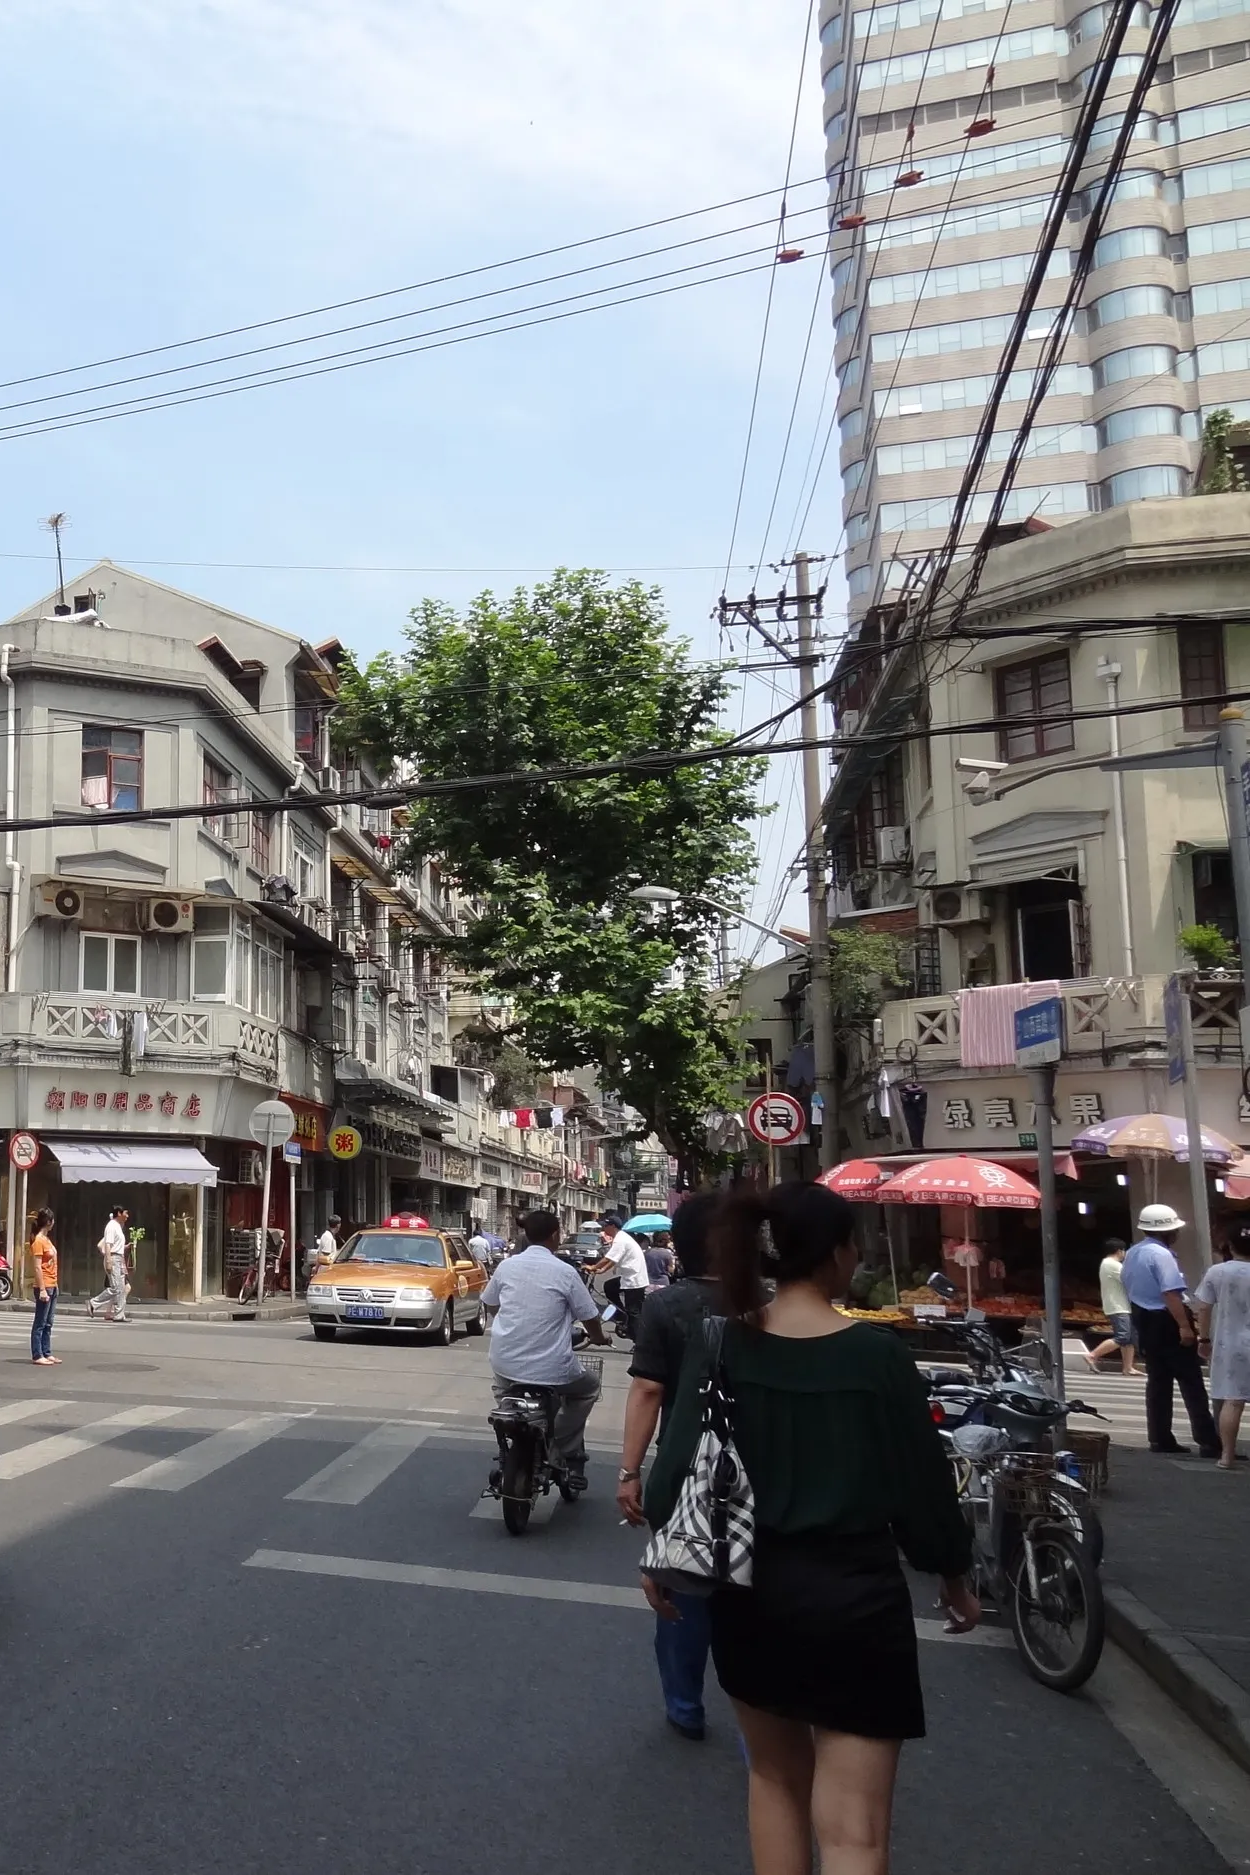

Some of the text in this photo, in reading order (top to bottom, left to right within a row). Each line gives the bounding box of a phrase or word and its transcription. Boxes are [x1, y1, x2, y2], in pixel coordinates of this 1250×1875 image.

[45, 1086, 201, 1118] 朝阳日用品商店
[335, 1133, 354, 1152] 粥
